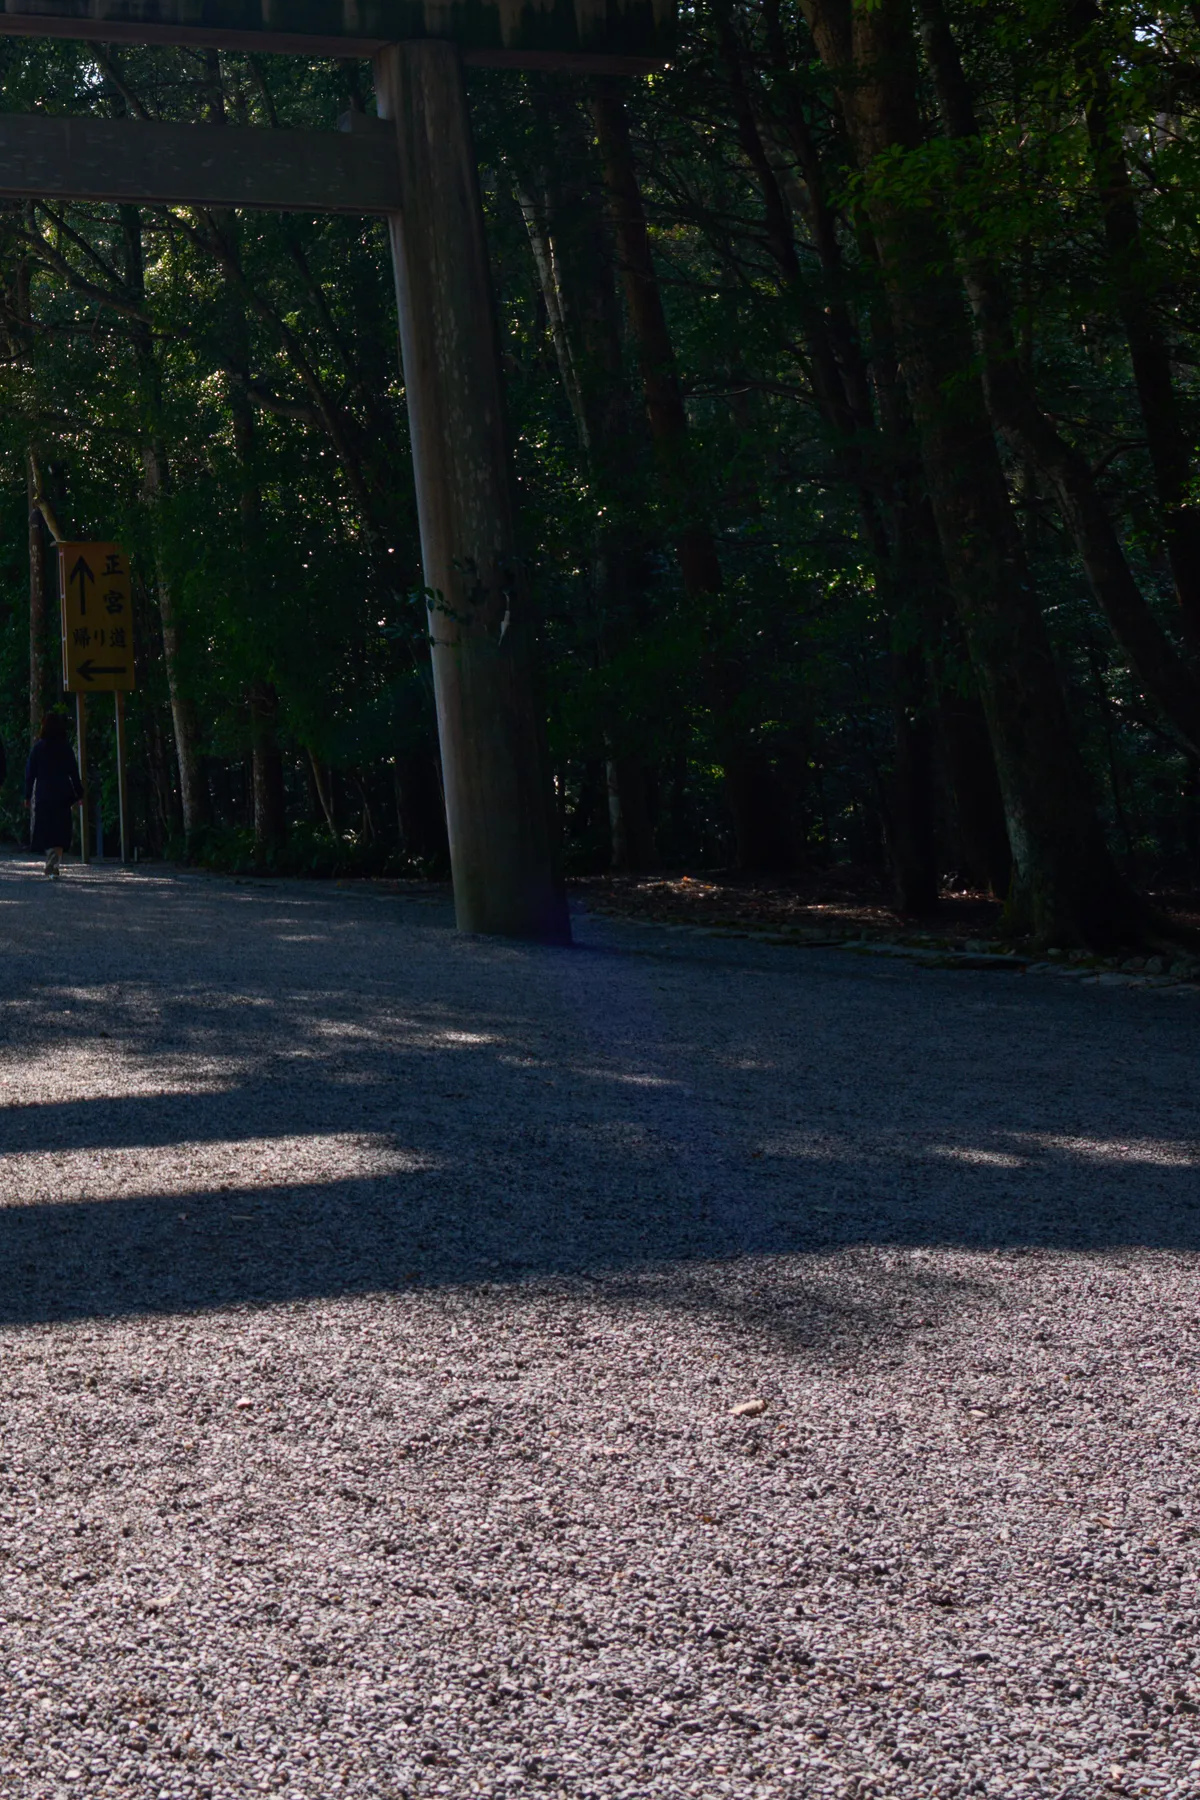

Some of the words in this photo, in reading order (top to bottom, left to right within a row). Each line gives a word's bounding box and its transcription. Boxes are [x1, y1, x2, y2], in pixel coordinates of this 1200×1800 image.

[101, 554, 125, 614] 正宮
[72, 627, 127, 648] 帰り道
